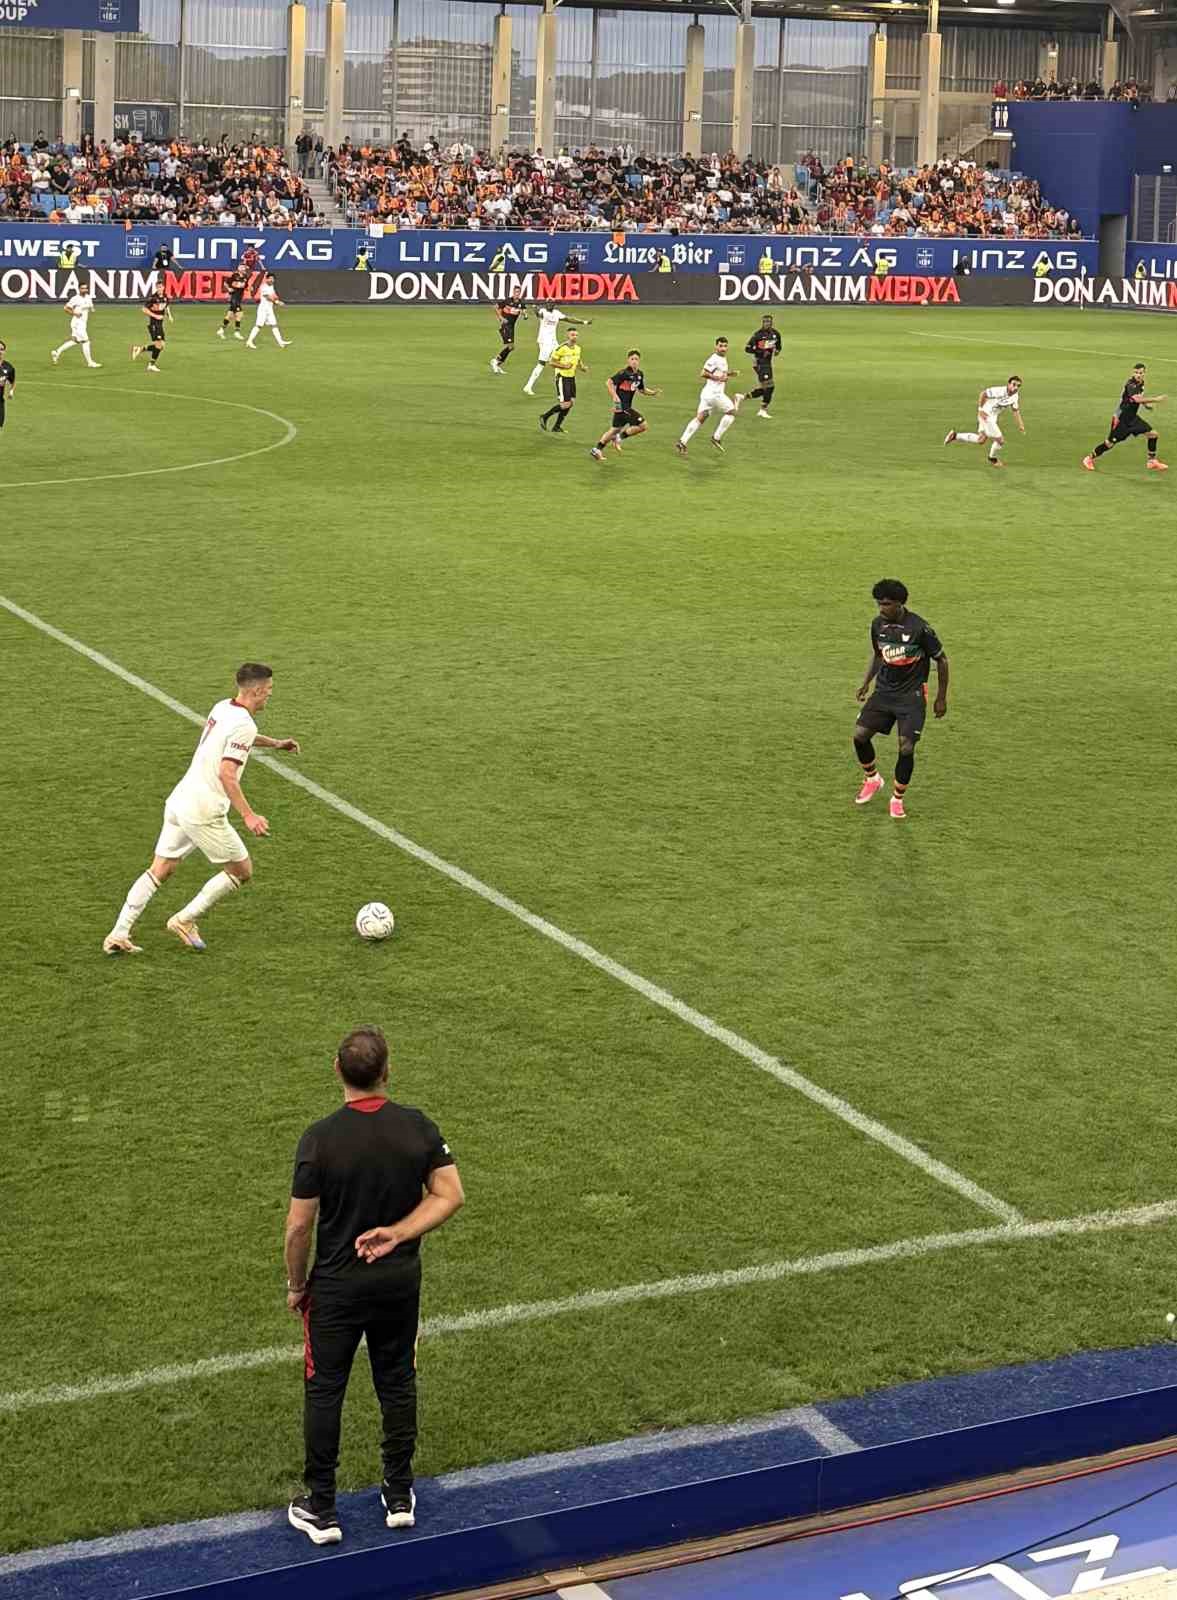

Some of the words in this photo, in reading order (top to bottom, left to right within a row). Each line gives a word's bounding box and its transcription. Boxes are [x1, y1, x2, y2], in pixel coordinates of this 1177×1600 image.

[0, 239, 100, 256] IWEST
[172, 237, 266, 260] LINZ
[275, 239, 333, 260] AG
[399, 241, 487, 262] LINZ
[500, 242, 548, 263] AG
[602, 240, 667, 263] Linze
[672, 241, 713, 265] Bier
[764, 246, 842, 267] LINZ
[849, 247, 897, 267] AG
[1031, 250, 1078, 270] AG
[1151, 258, 1177, 278] LI
